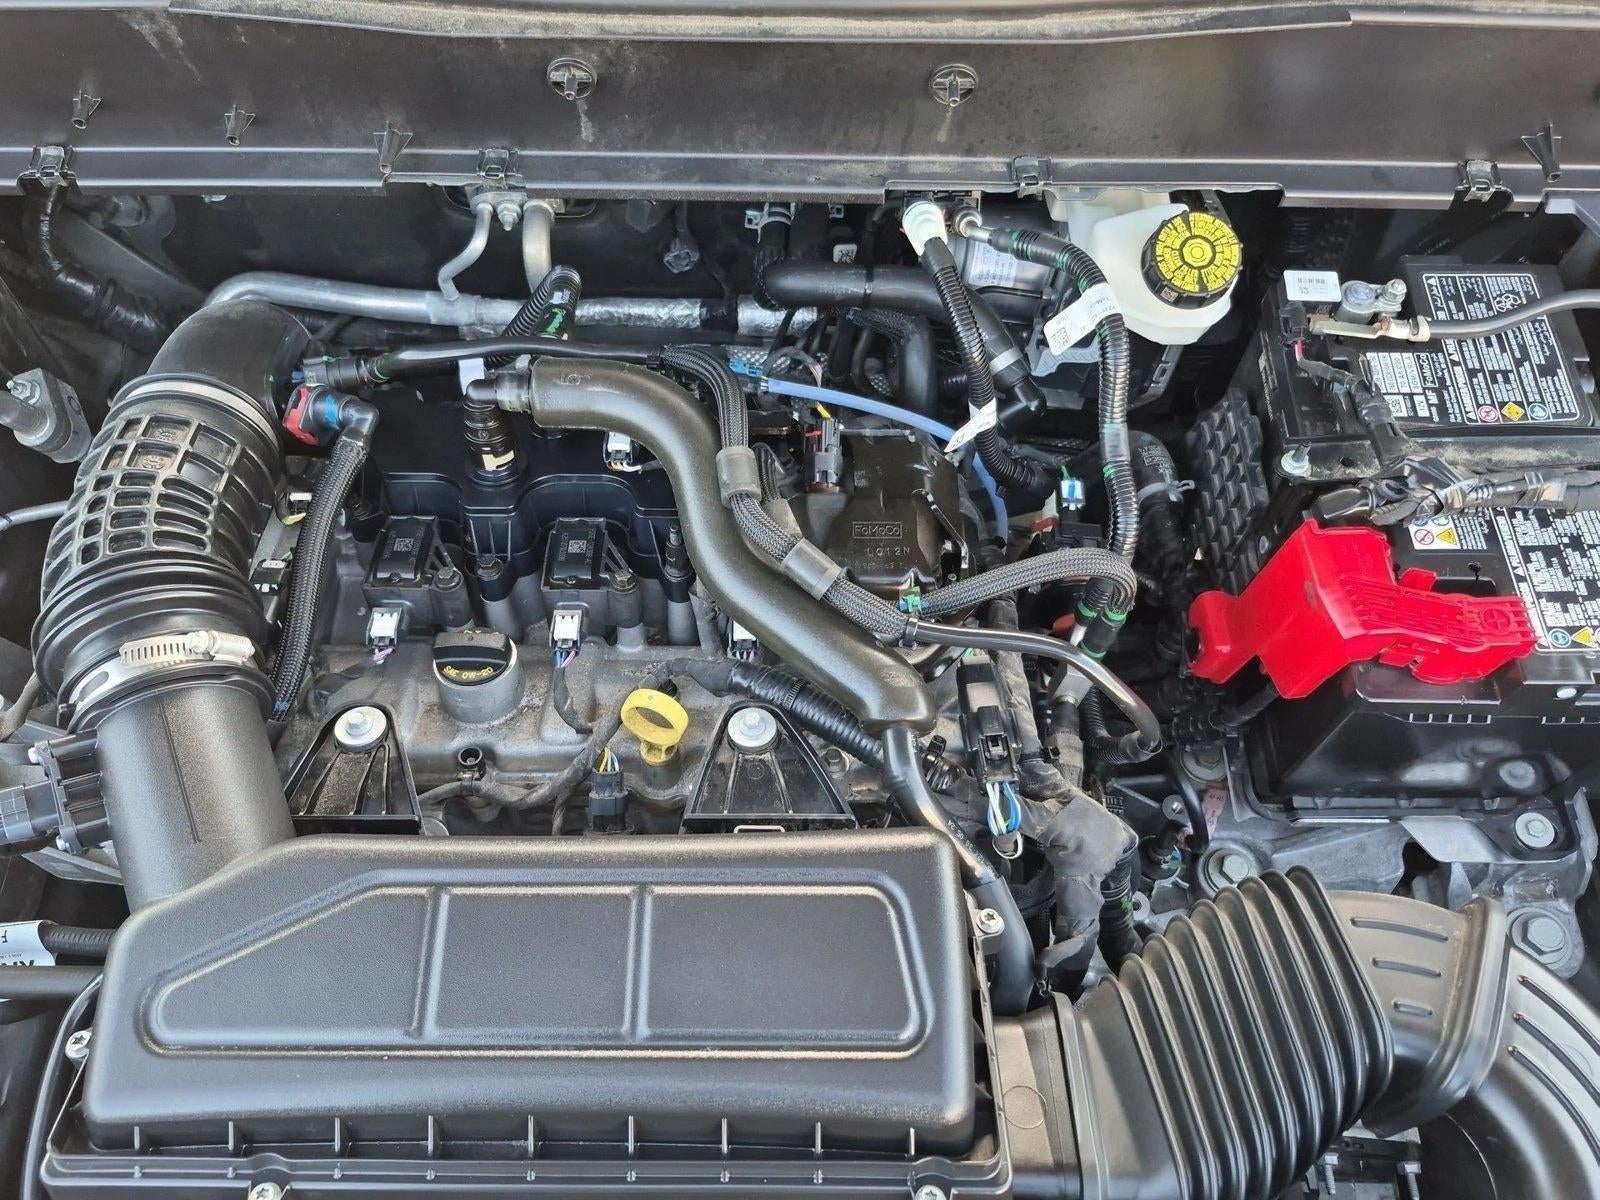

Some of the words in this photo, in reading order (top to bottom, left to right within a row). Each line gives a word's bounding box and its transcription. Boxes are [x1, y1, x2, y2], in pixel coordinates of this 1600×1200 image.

[1407, 357, 1419, 389] AGM/VRLA
[1420, 354, 1434, 385] FoMoCo
[1426, 390, 1438, 404] MF
[854, 524, 901, 536] FoMoCo
[444, 665, 460, 677] SAE
